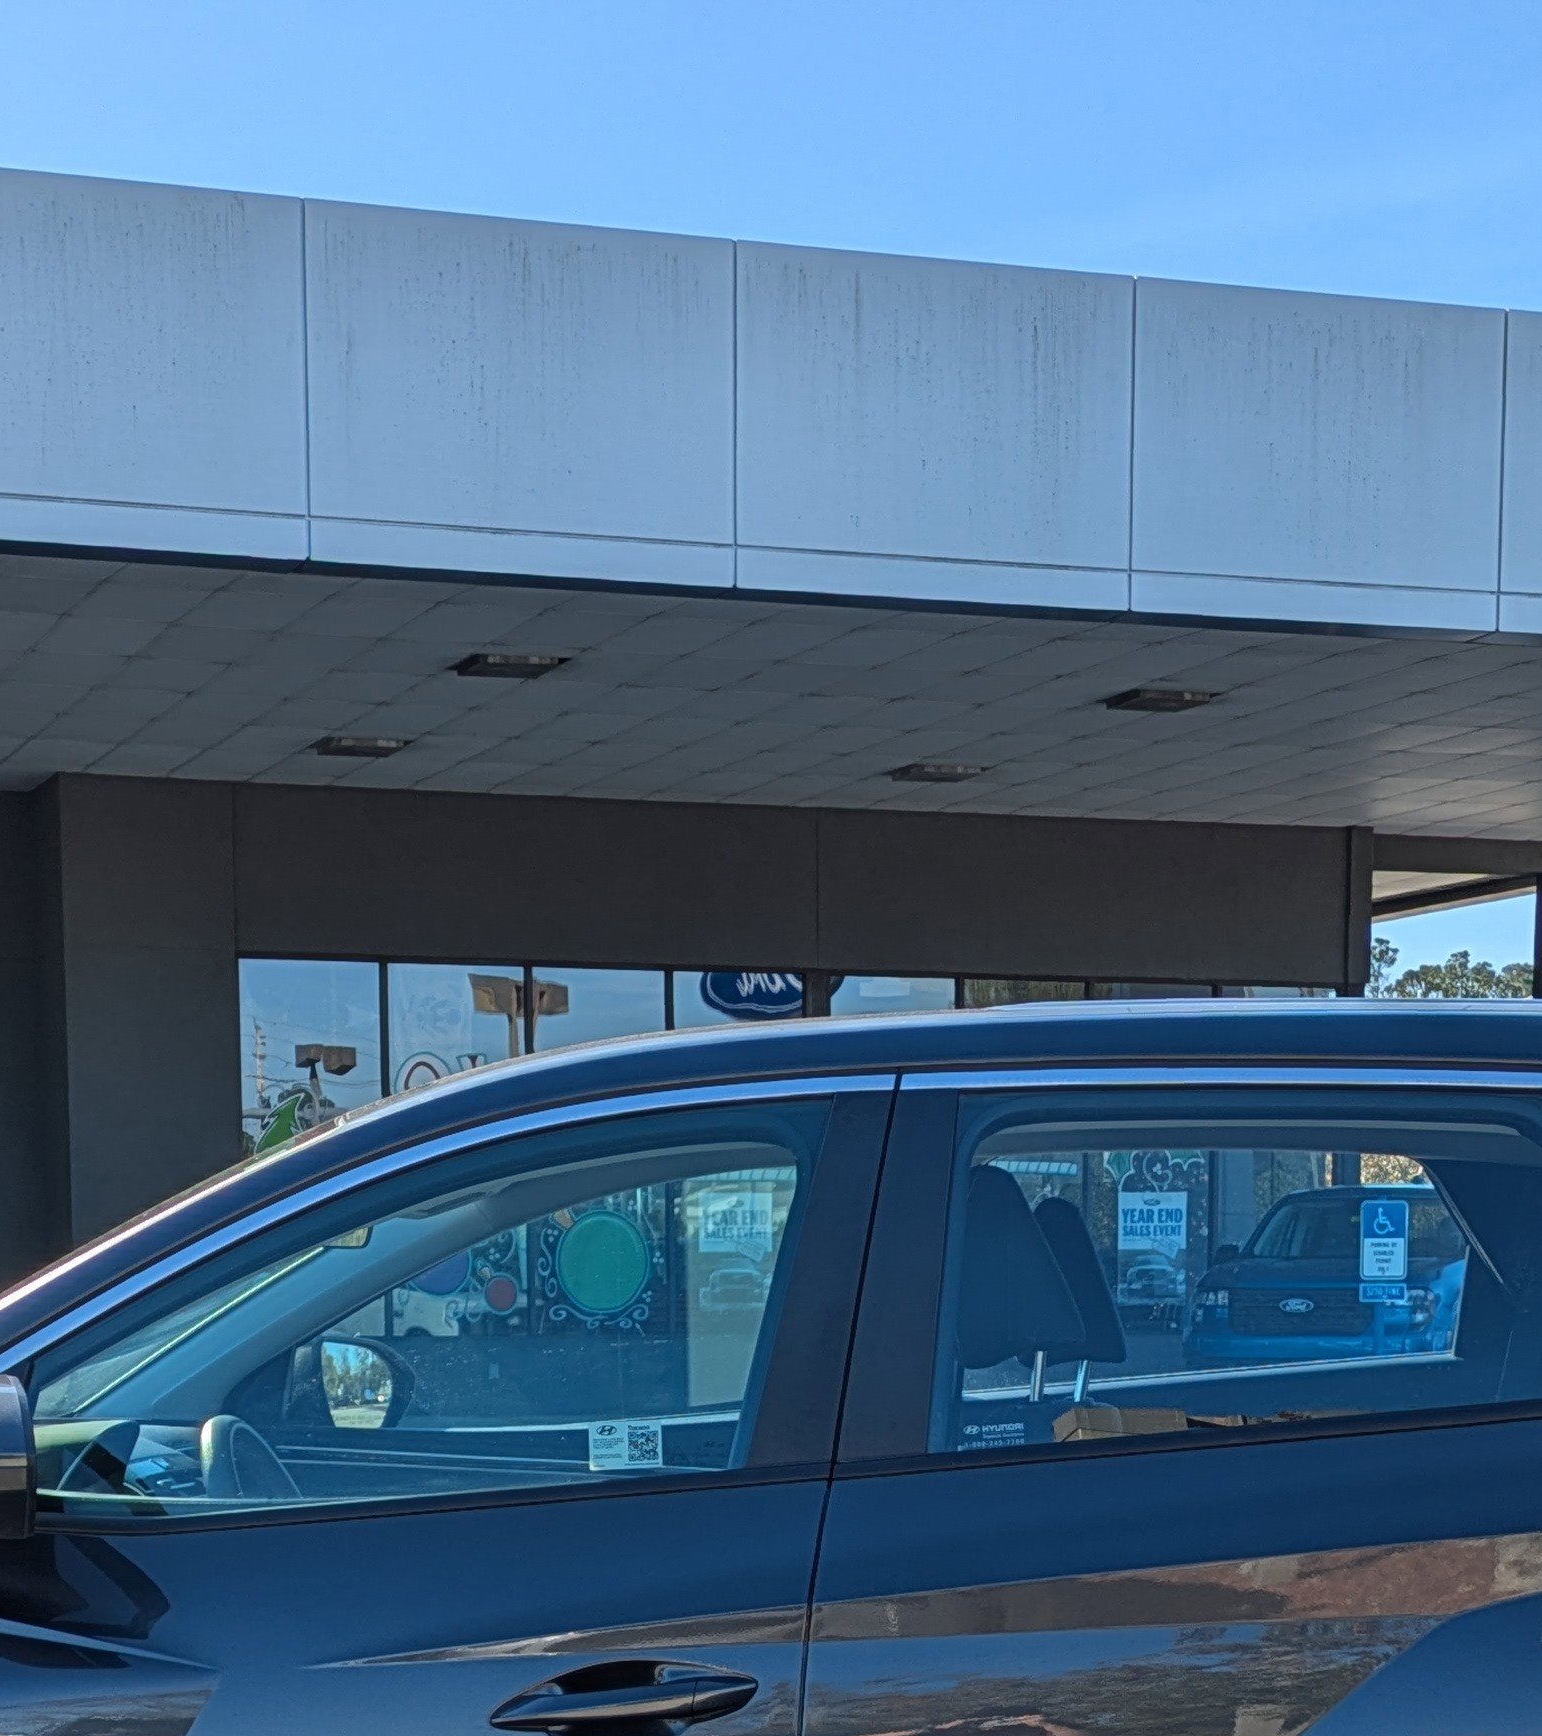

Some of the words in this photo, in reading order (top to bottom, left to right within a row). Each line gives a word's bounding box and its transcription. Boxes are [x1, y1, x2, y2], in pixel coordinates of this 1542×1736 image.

[1121, 1208, 1155, 1224] YEAR
[1157, 1208, 1184, 1224] END
[1122, 1225, 1152, 1238] SALES
[1153, 1224, 1182, 1237] EVENT
[982, 1422, 1025, 1433] HYUNDAI
